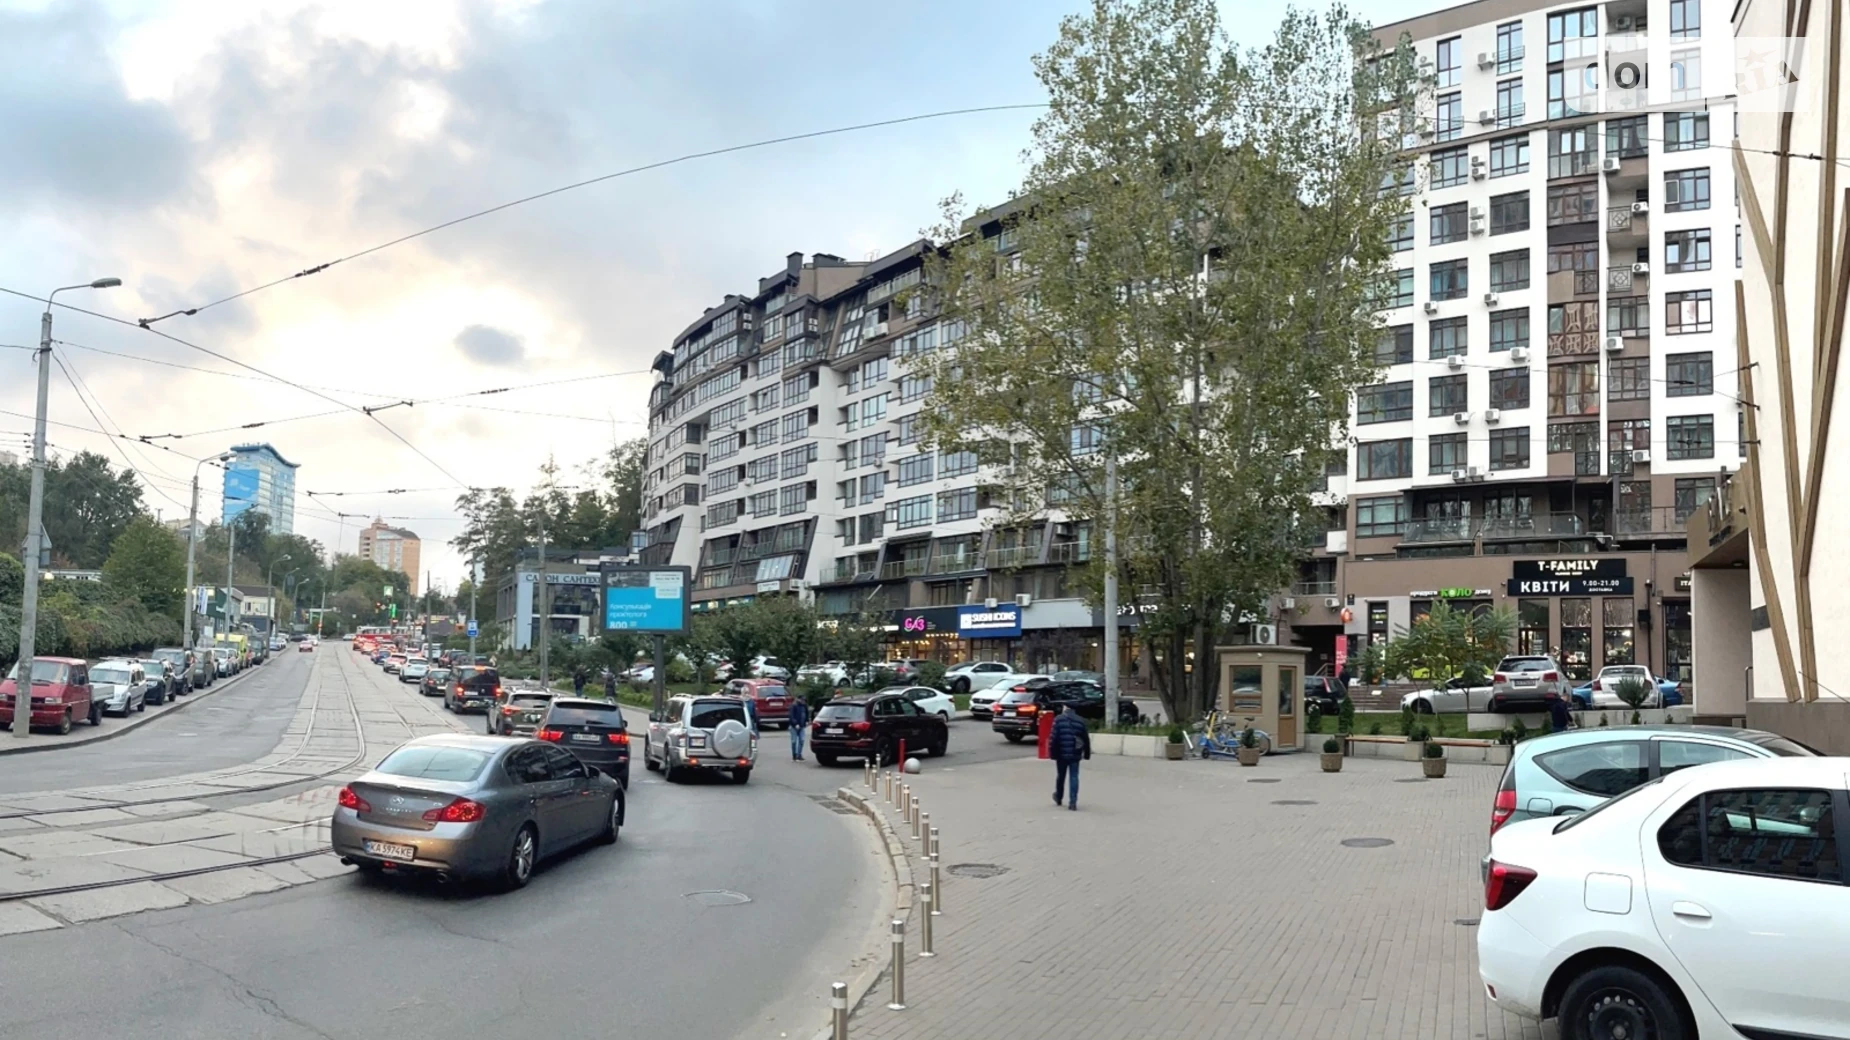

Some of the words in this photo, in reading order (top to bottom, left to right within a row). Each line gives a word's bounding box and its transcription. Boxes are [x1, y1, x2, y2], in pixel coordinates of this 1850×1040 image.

[1538, 560, 1598, 571] T-FAMILY
[525, 574, 559, 583] САОН
[1440, 587, 1472, 598] КОЛО
[1521, 581, 1570, 593] КВІТИ
